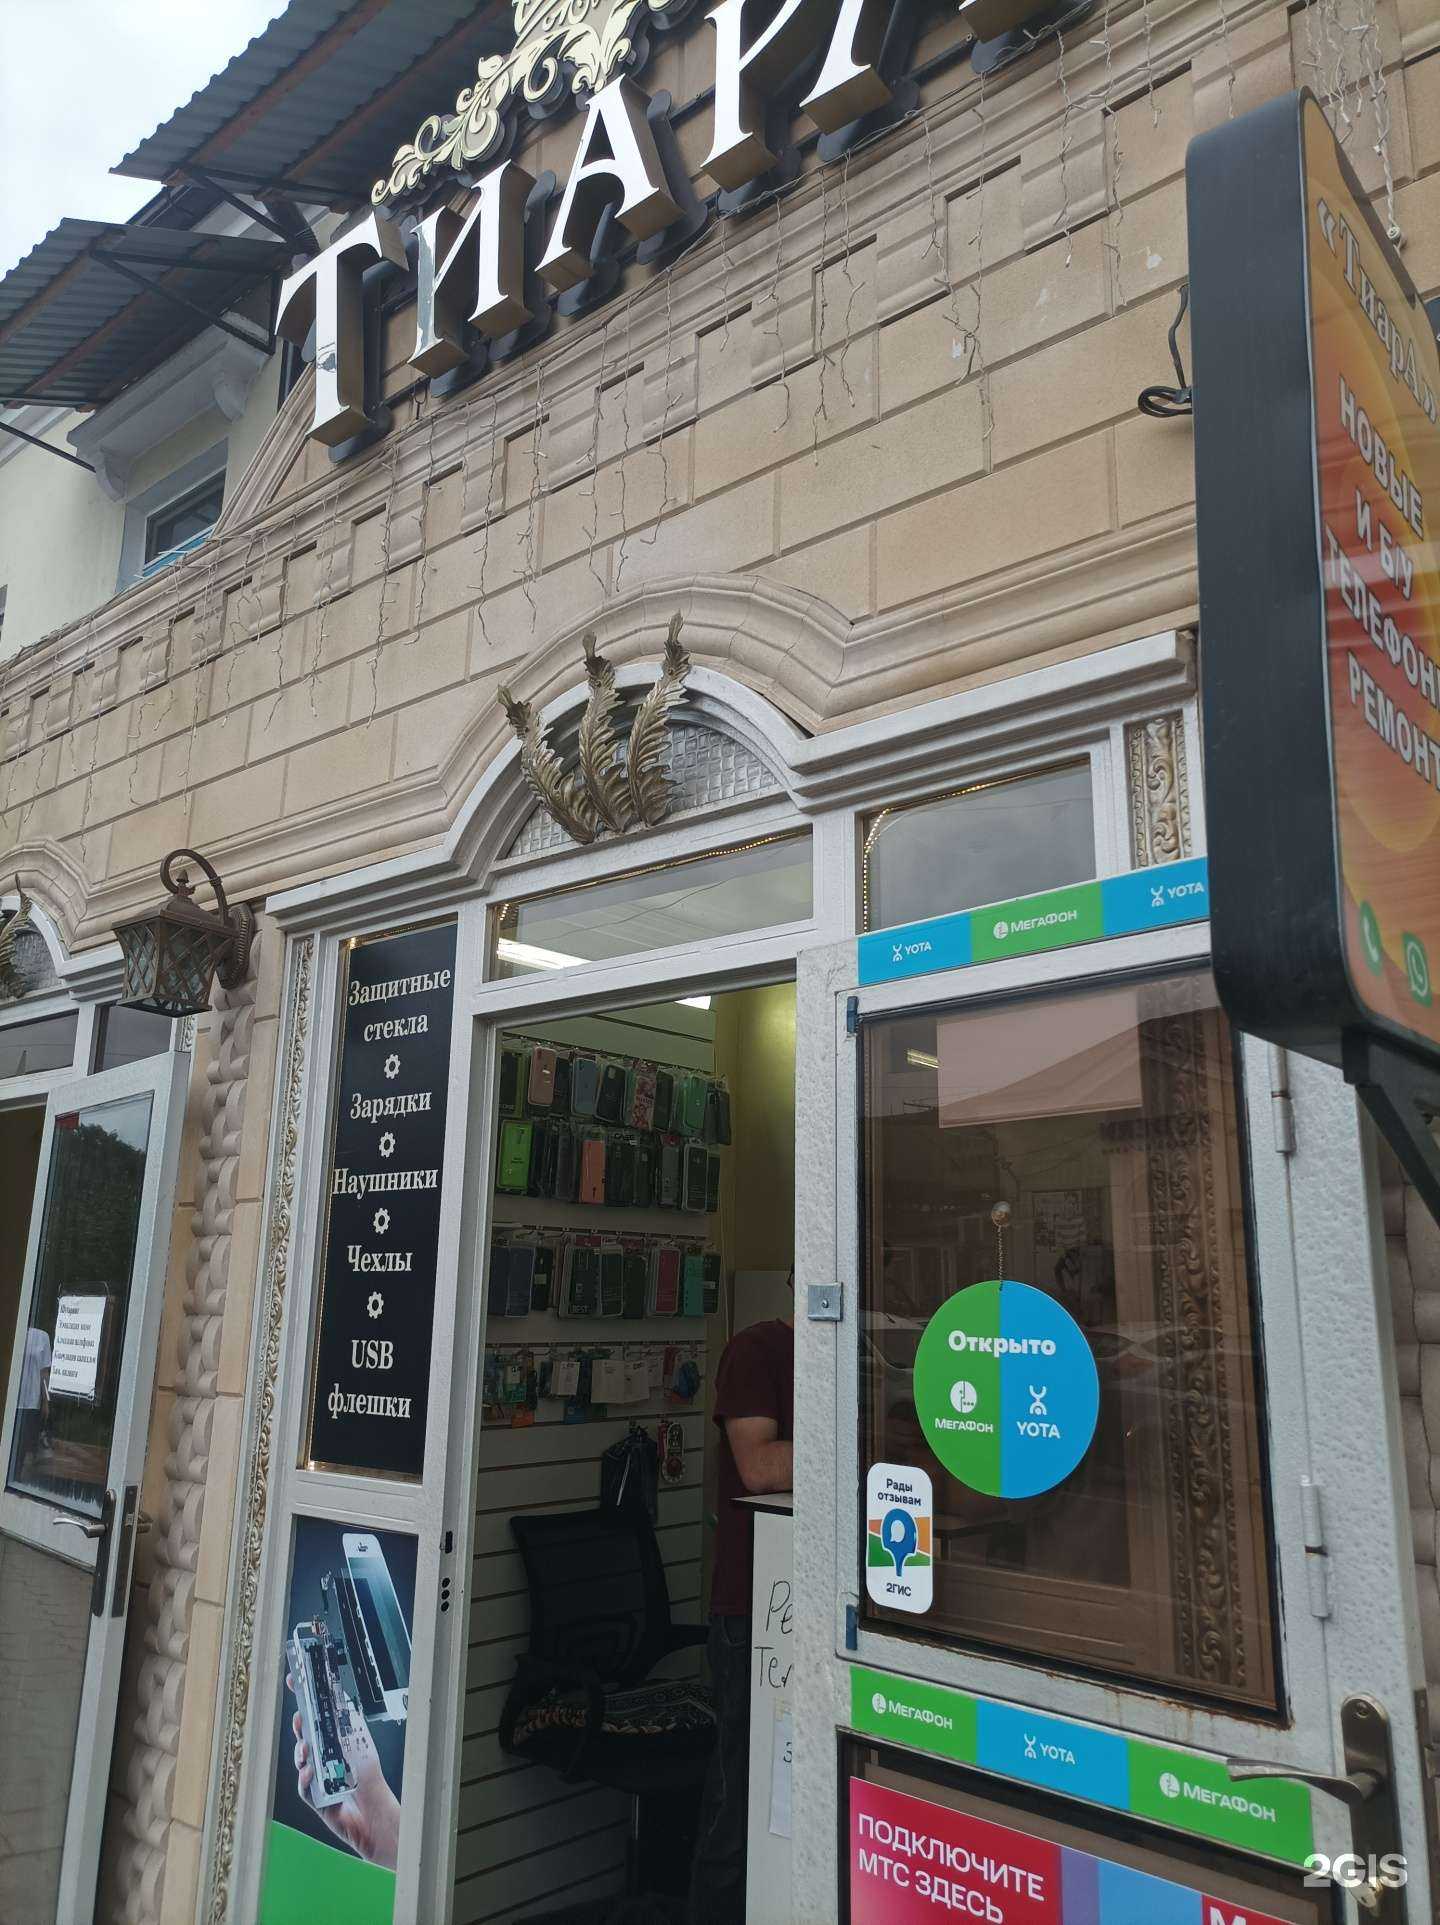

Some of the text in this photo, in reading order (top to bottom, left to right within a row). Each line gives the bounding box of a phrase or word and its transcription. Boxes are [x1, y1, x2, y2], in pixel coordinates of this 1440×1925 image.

[1339, 373, 1424, 541] НОВЫЕ
[1355, 485, 1413, 601] И Б/У
[1325, 522, 1440, 712] ТЕЛЕФОН
[1348, 648, 1440, 791] РЕМОНТ
[1167, 880, 1205, 899] YOTA
[905, 941, 932, 955] YOTA
[349, 968, 451, 1007] Защитные
[364, 1013, 429, 1042] стекла
[350, 1092, 432, 1124] Зарядки
[332, 1168, 439, 1200] Наушники
[347, 1245, 413, 1272] Чехлы
[351, 1339, 394, 1370] USB
[948, 1330, 1056, 1358] Открыто
[327, 1383, 412, 1419] флешки
[1016, 1421, 1060, 1439] YOTA
[877, 1492, 921, 1506] отзывам
[886, 1478, 913, 1493] Рады
[886, 1582, 912, 1597] 2ГИС
[1040, 1744, 1076, 1766] YOTA
[858, 1813, 1045, 1902] ПОДКЛЮЧИТЕ
[858, 1848, 1004, 1925] МТС ЗДЕСЬ
